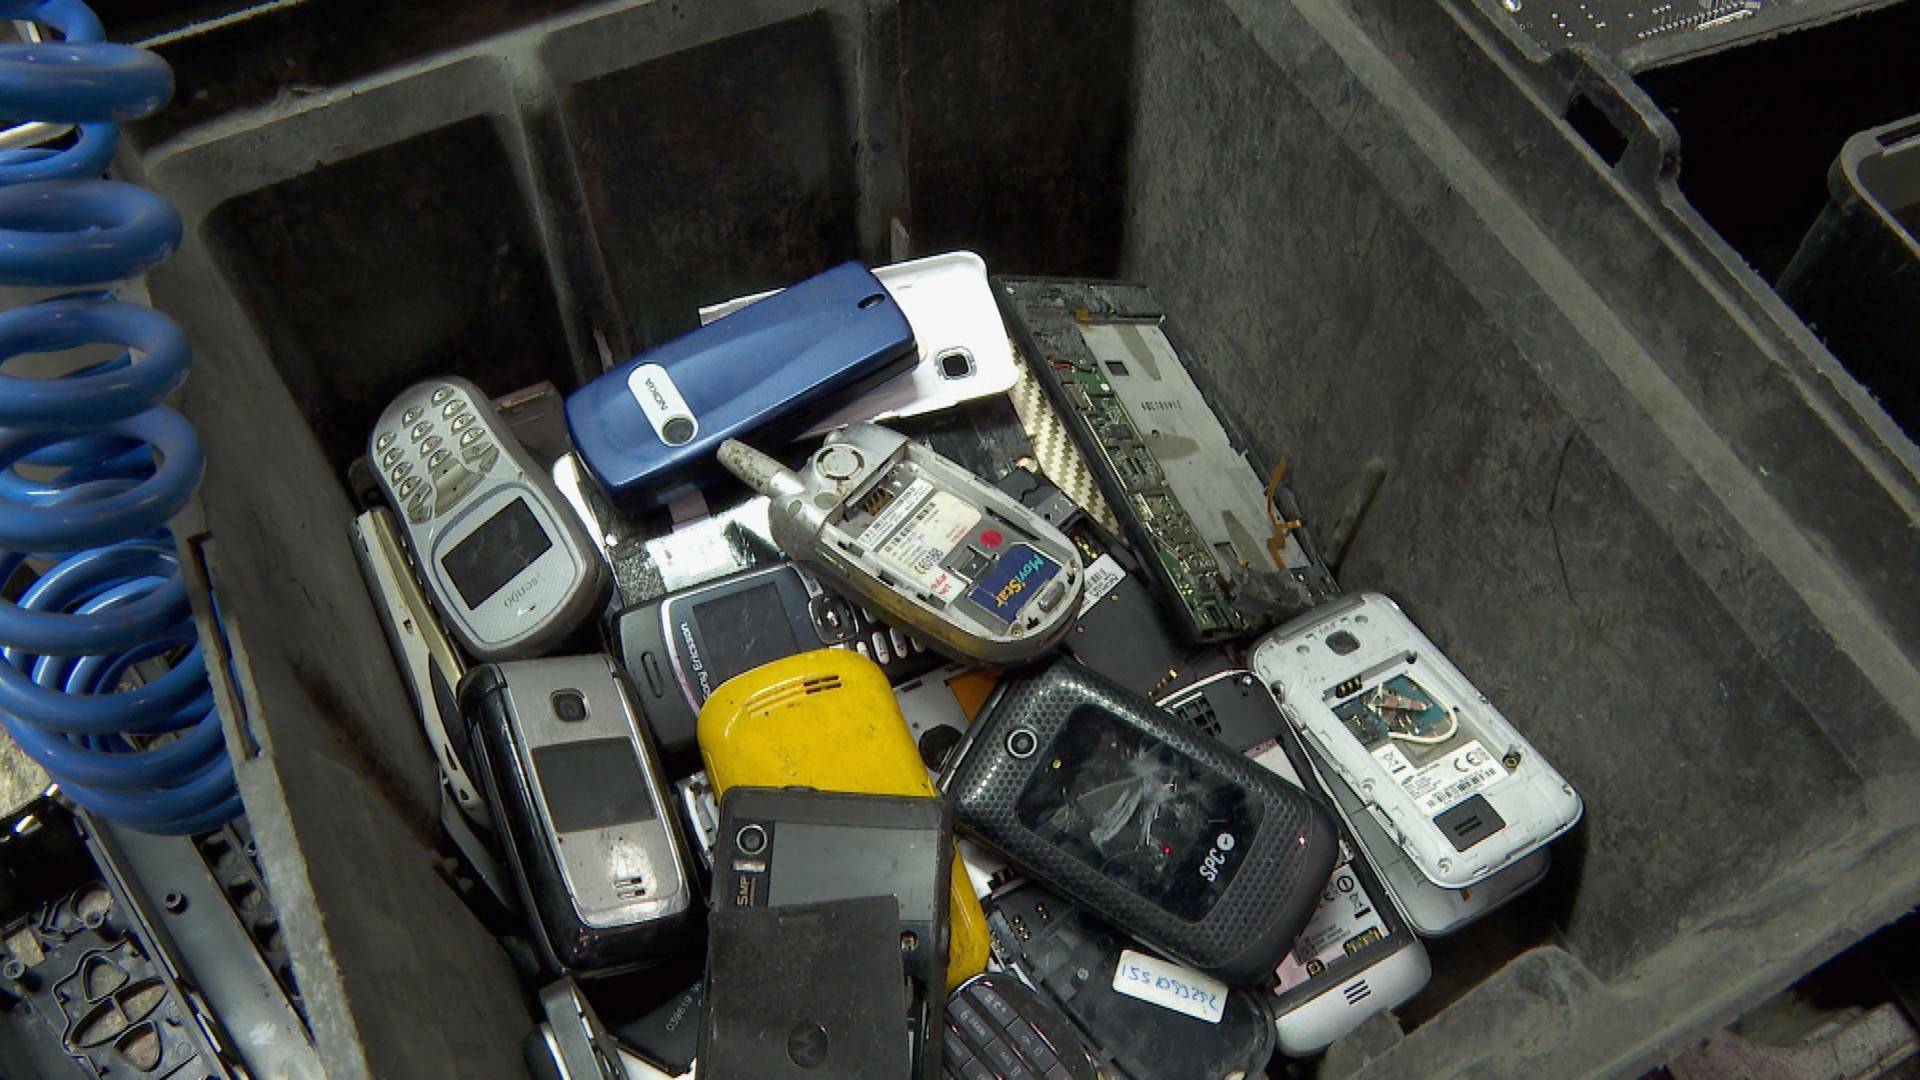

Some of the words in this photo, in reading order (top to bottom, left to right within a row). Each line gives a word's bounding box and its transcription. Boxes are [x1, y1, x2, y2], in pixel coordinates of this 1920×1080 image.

[645, 377, 669, 411] NOKIA
[680, 621, 703, 671] Ericsson
[1199, 847, 1226, 882] SPC
